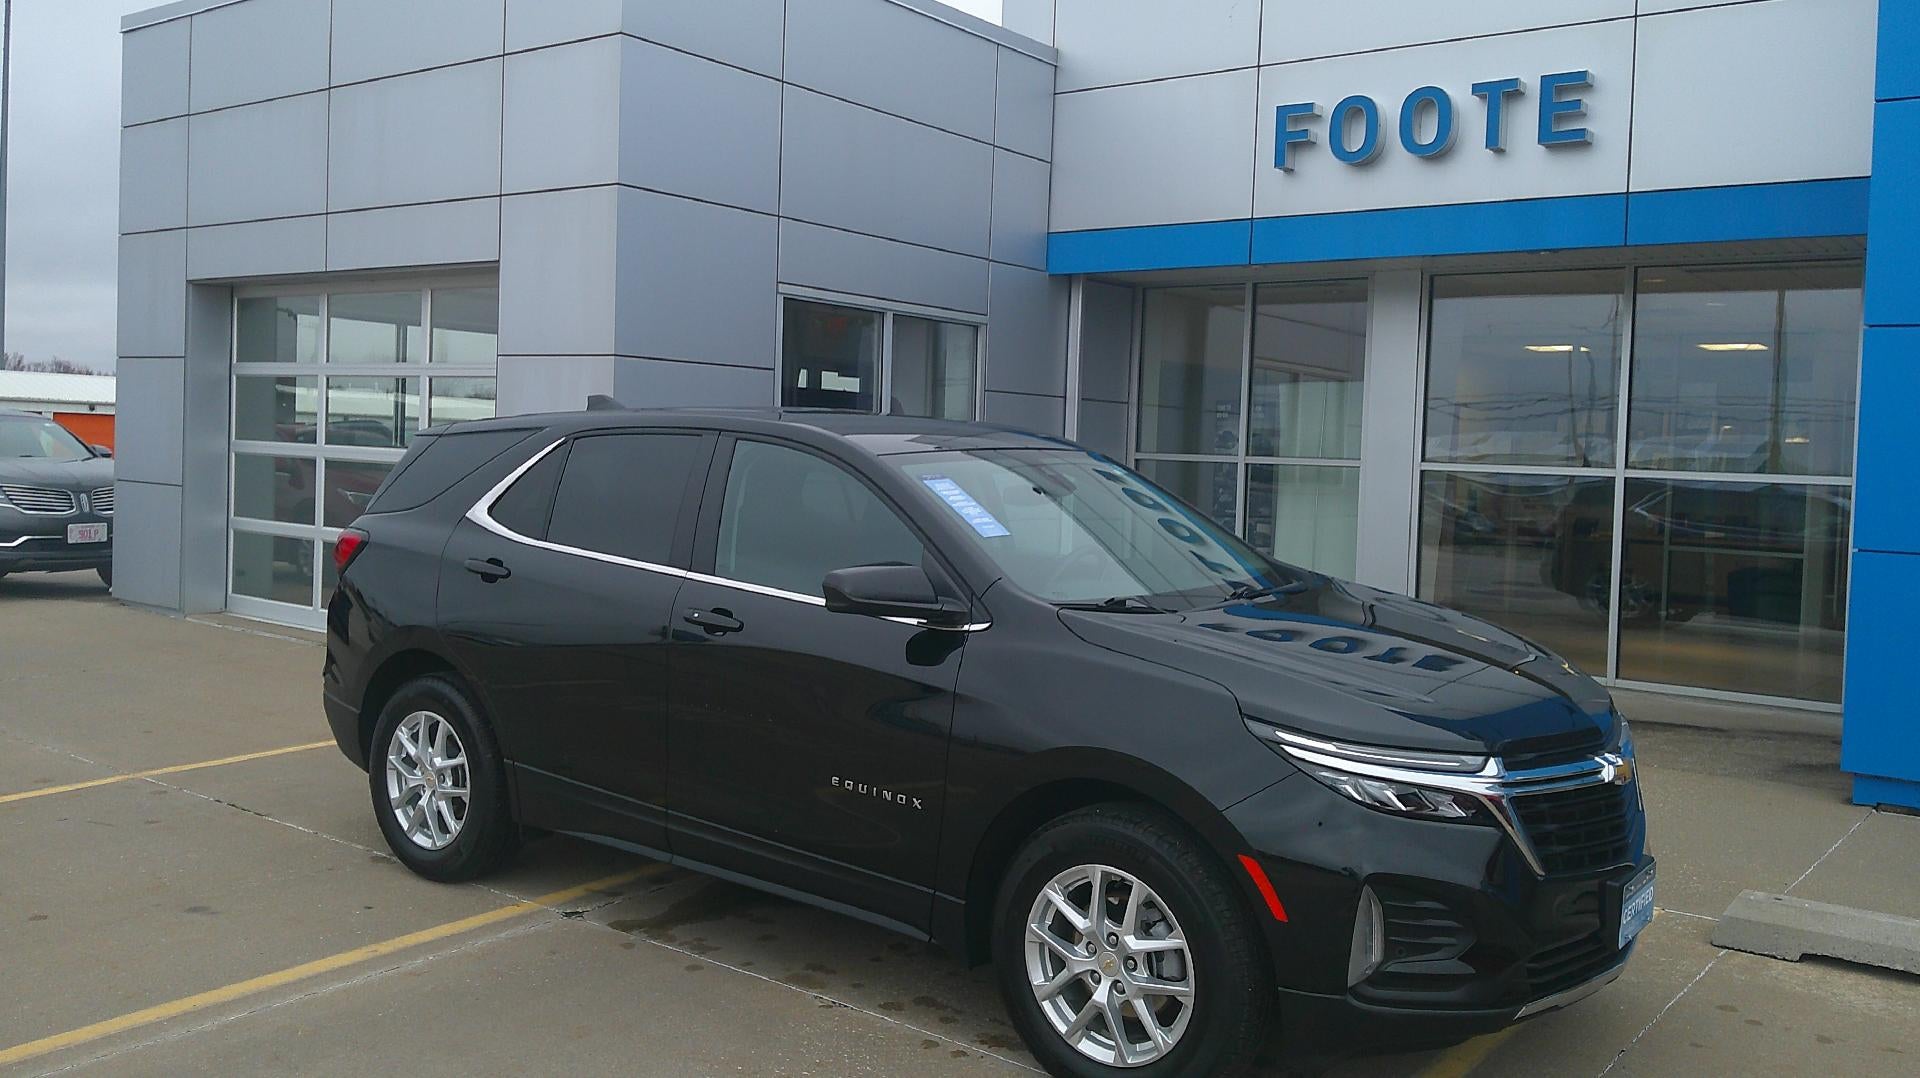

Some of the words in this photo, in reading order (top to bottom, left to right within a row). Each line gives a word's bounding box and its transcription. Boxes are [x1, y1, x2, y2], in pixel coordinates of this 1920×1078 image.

[1274, 69, 1594, 173] FOOTE
[831, 776, 922, 809] EQUINOX
[1623, 886, 1654, 924] CERTIFIED
